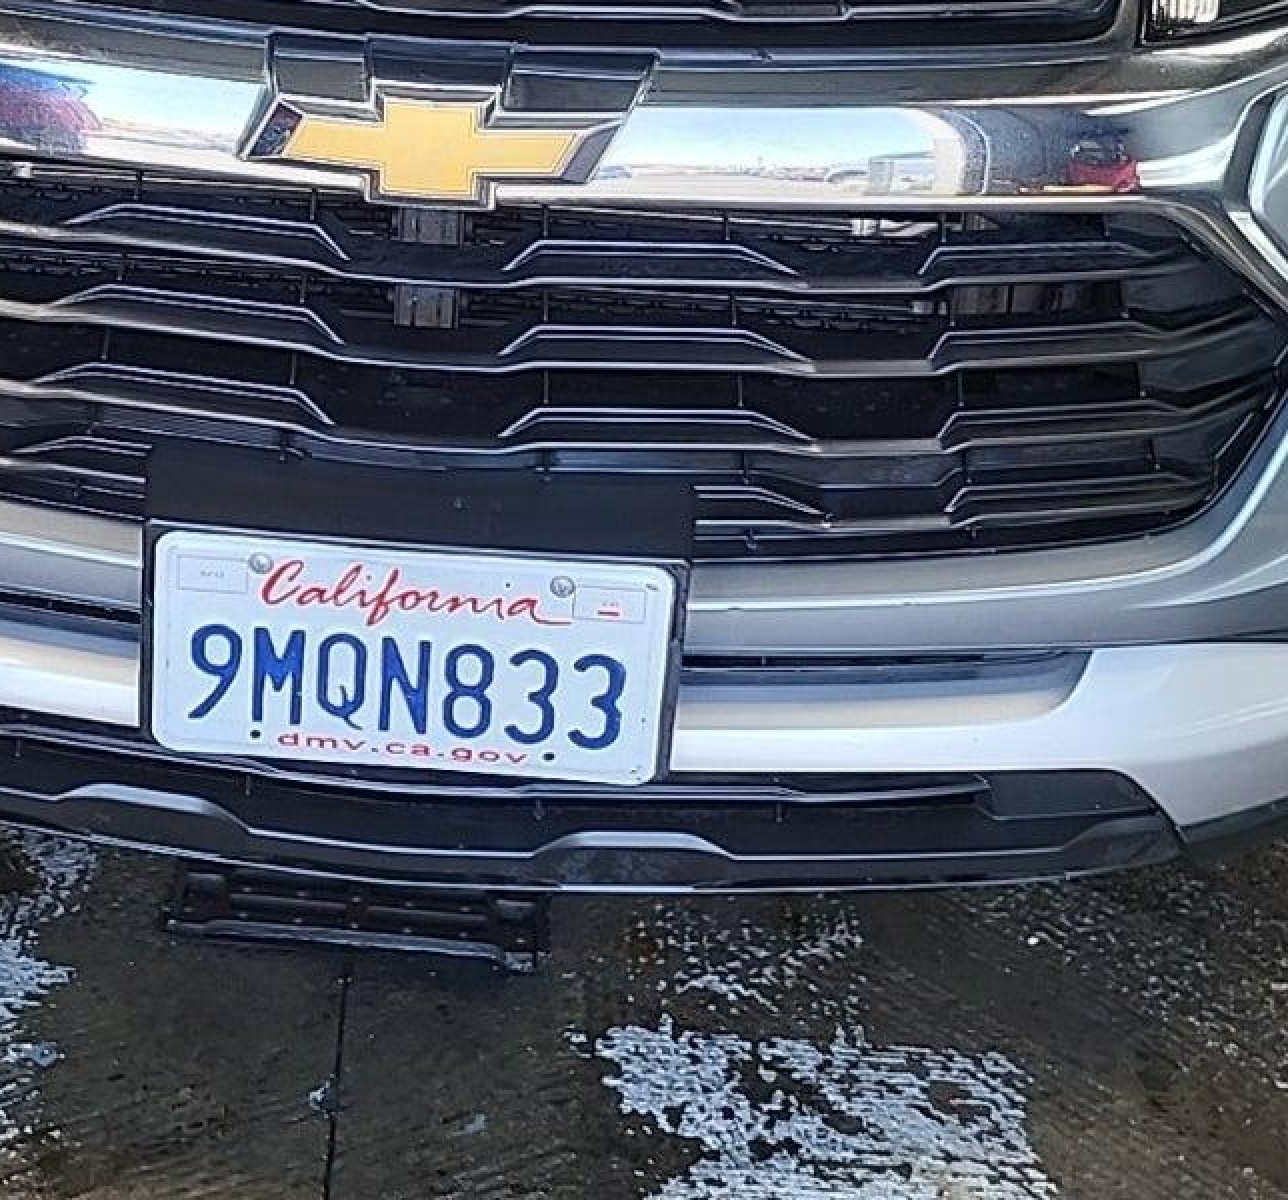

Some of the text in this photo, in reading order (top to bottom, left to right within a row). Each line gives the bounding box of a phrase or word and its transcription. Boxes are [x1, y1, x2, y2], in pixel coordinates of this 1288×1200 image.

[262, 559, 572, 628] California
[187, 622, 627, 751] 9MQN833
[277, 730, 529, 766] dmv.ca.gov
